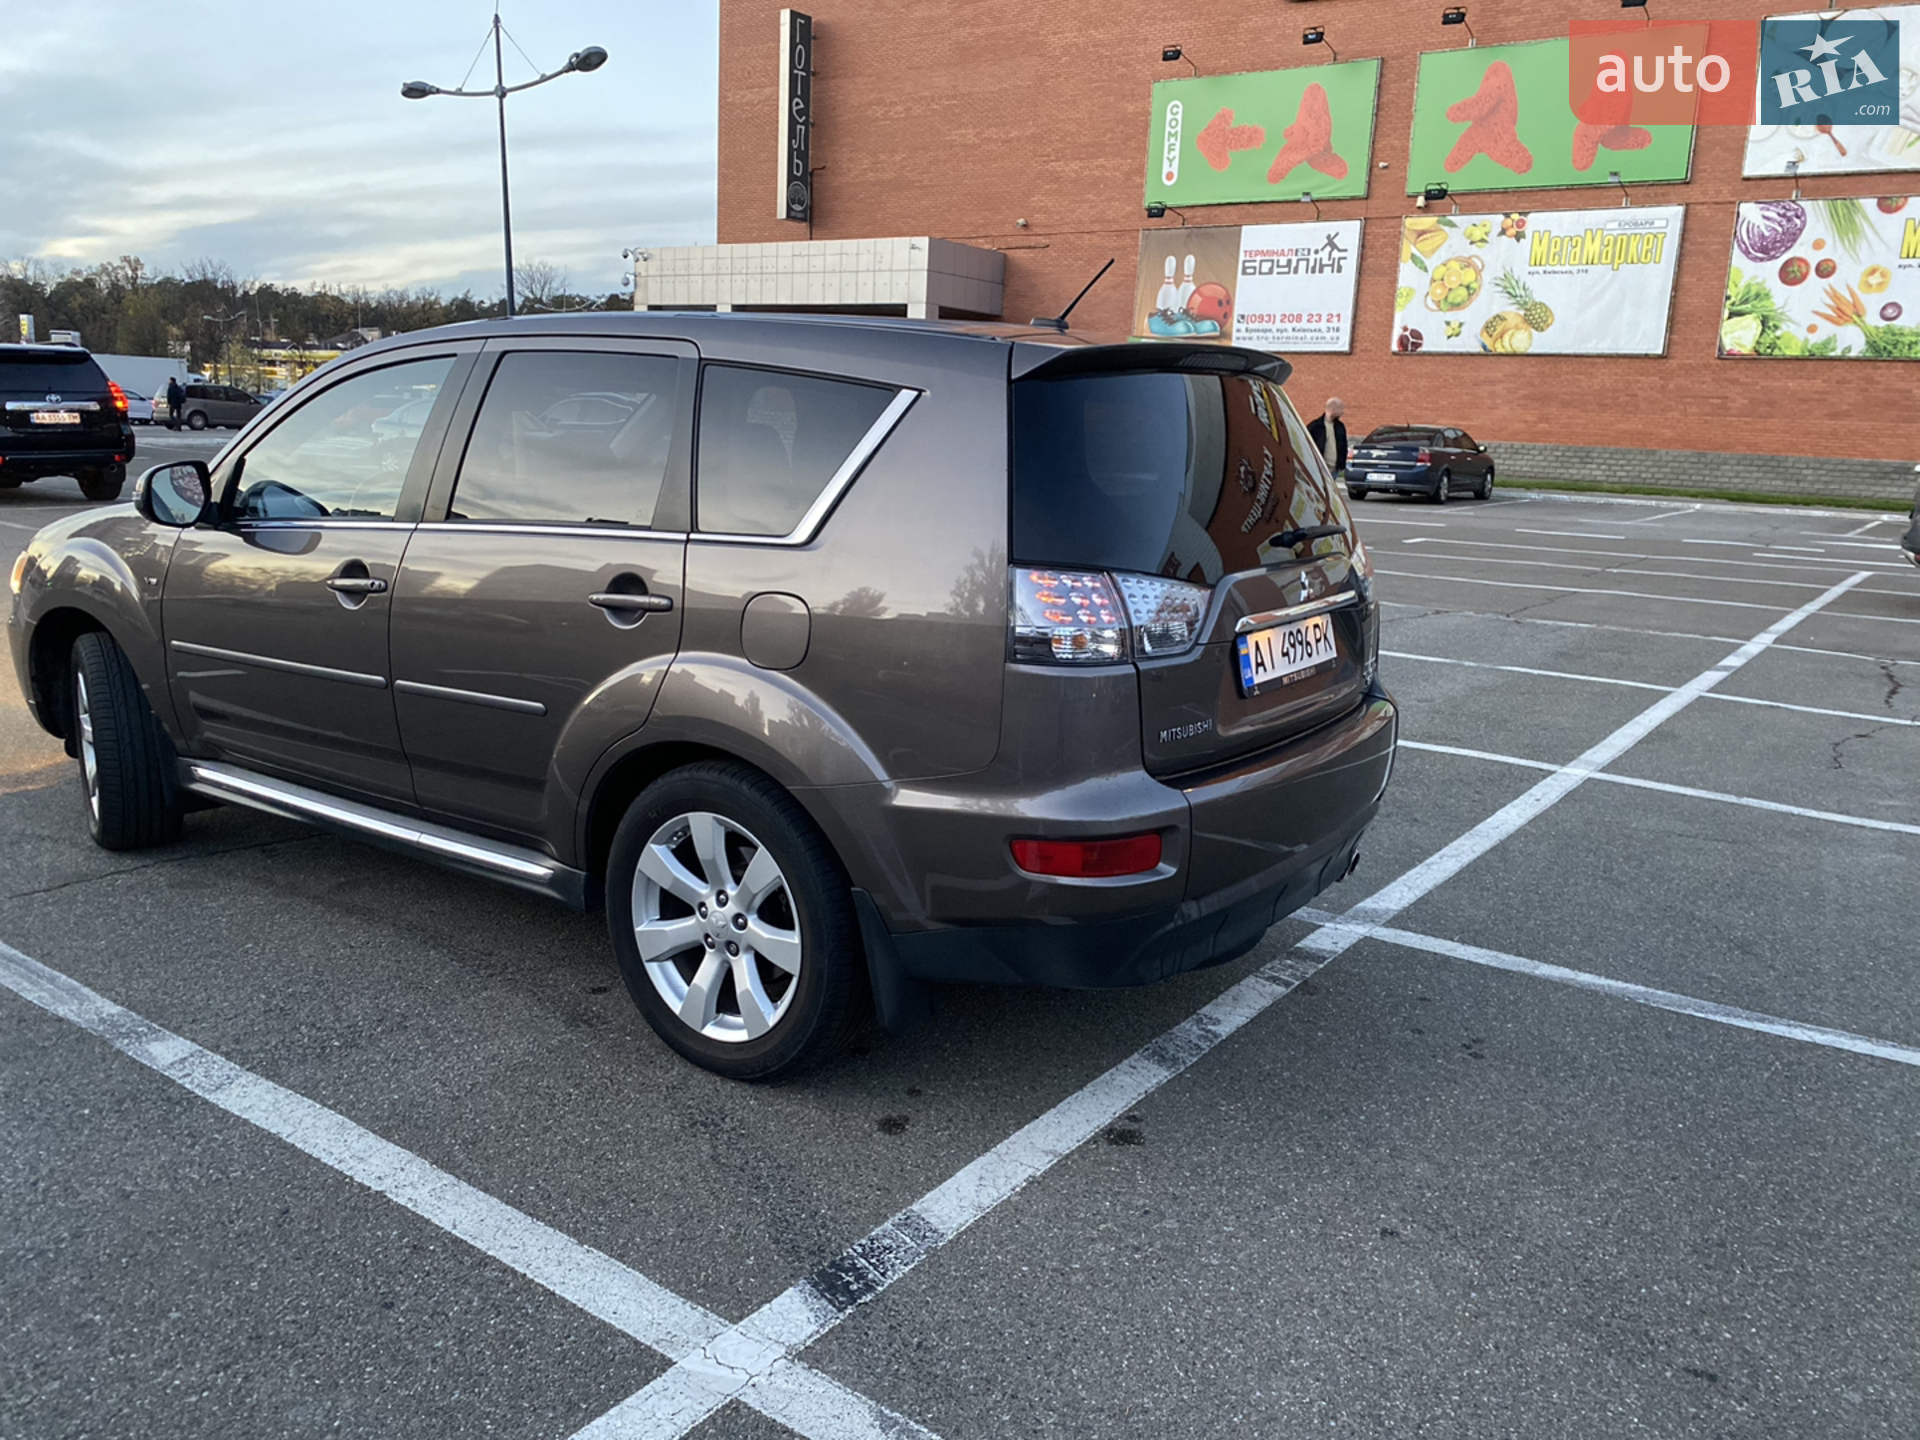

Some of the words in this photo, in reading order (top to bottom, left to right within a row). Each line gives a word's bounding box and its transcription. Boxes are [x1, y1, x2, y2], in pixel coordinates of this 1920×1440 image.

[1166, 103, 1180, 168] COMFY
[1243, 248, 1293, 258] ТЕРМІНАЛ
[1529, 229, 1667, 271] МегаМаркет
[1241, 257, 1348, 276] БОУЛІНГ
[1246, 313, 1276, 325] (093)
[1280, 313, 1303, 324] 208
[1306, 313, 1322, 324] 23
[1326, 313, 1341, 324] 21
[1255, 636, 1275, 675] AI
[1281, 625, 1313, 665] 4996
[1313, 619, 1332, 655] PK
[1282, 667, 1316, 685] MITSUBISHI
[1160, 718, 1212, 743] MITSUBISHI
